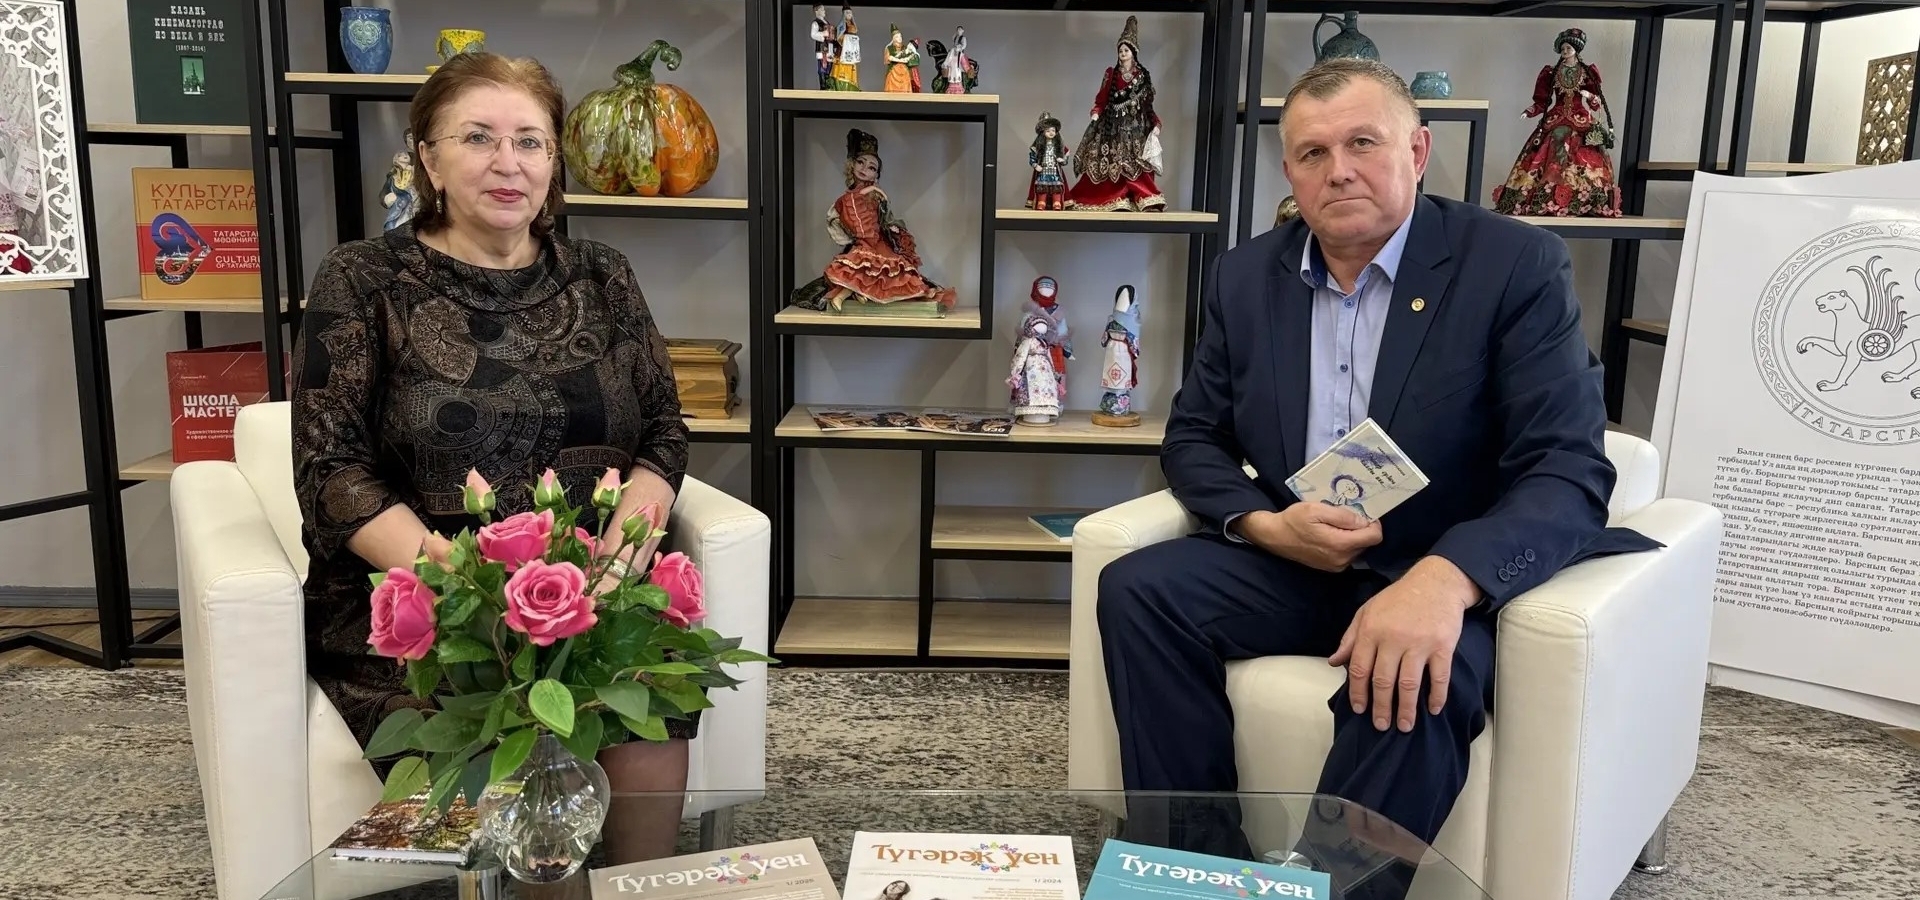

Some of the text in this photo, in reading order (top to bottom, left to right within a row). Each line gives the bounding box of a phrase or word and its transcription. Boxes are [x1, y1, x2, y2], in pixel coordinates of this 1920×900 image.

[170, 6, 206, 15] КАЗАНЬ
[154, 18, 224, 29] КИНЕМАТОГРАФ
[155, 31, 224, 42] ИЗ ВЕКА В ВЕК
[152, 184, 256, 198] КУЛЬТУРА
[152, 199, 256, 210] ТАТАРСТАНА
[182, 394, 239, 406] ШКОЛА
[1801, 407, 1920, 442] ТАТАРСТА
[1889, 517, 1920, 526] яклау
[872, 844, 1060, 868] Түгәрәк уен
[608, 867, 744, 894] Түгәрәк
[748, 854, 810, 876] уен
[1118, 854, 1246, 888] Түгәрәк
[1254, 878, 1316, 900] уен
